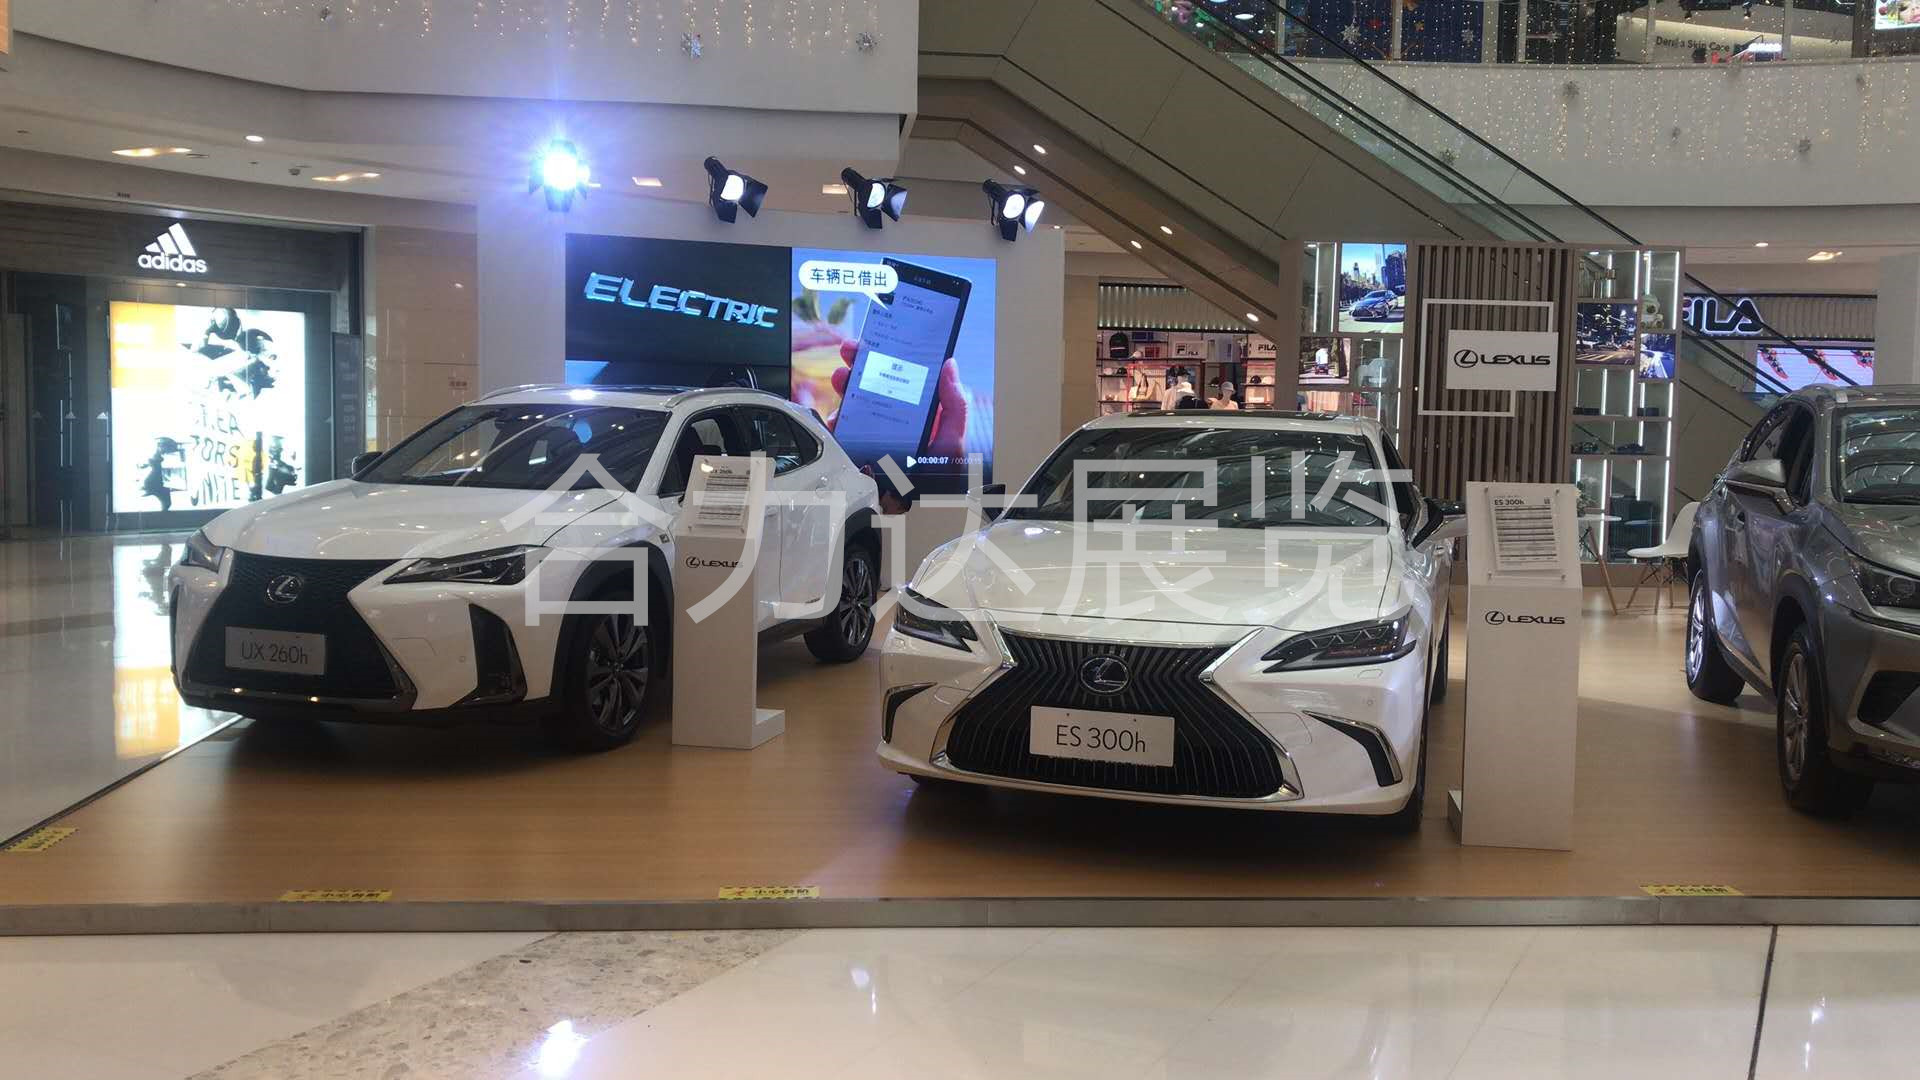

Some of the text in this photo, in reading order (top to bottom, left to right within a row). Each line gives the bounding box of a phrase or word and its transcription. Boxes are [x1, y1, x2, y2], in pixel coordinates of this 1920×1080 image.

[1688, 39, 1707, 49] Skin
[1709, 42, 1730, 52] Care
[138, 252, 208, 273] adidas
[810, 267, 888, 287] 车辆已借出
[584, 272, 778, 328] ELECTRIC
[1480, 354, 1551, 365] LEXUS
[190, 435, 241, 468] TORS
[917, 456, 949, 465] 00:00:07
[1507, 615, 1566, 625] LEXUS
[241, 640, 308, 664] UX 260h
[1056, 724, 1146, 752] ES 300h
